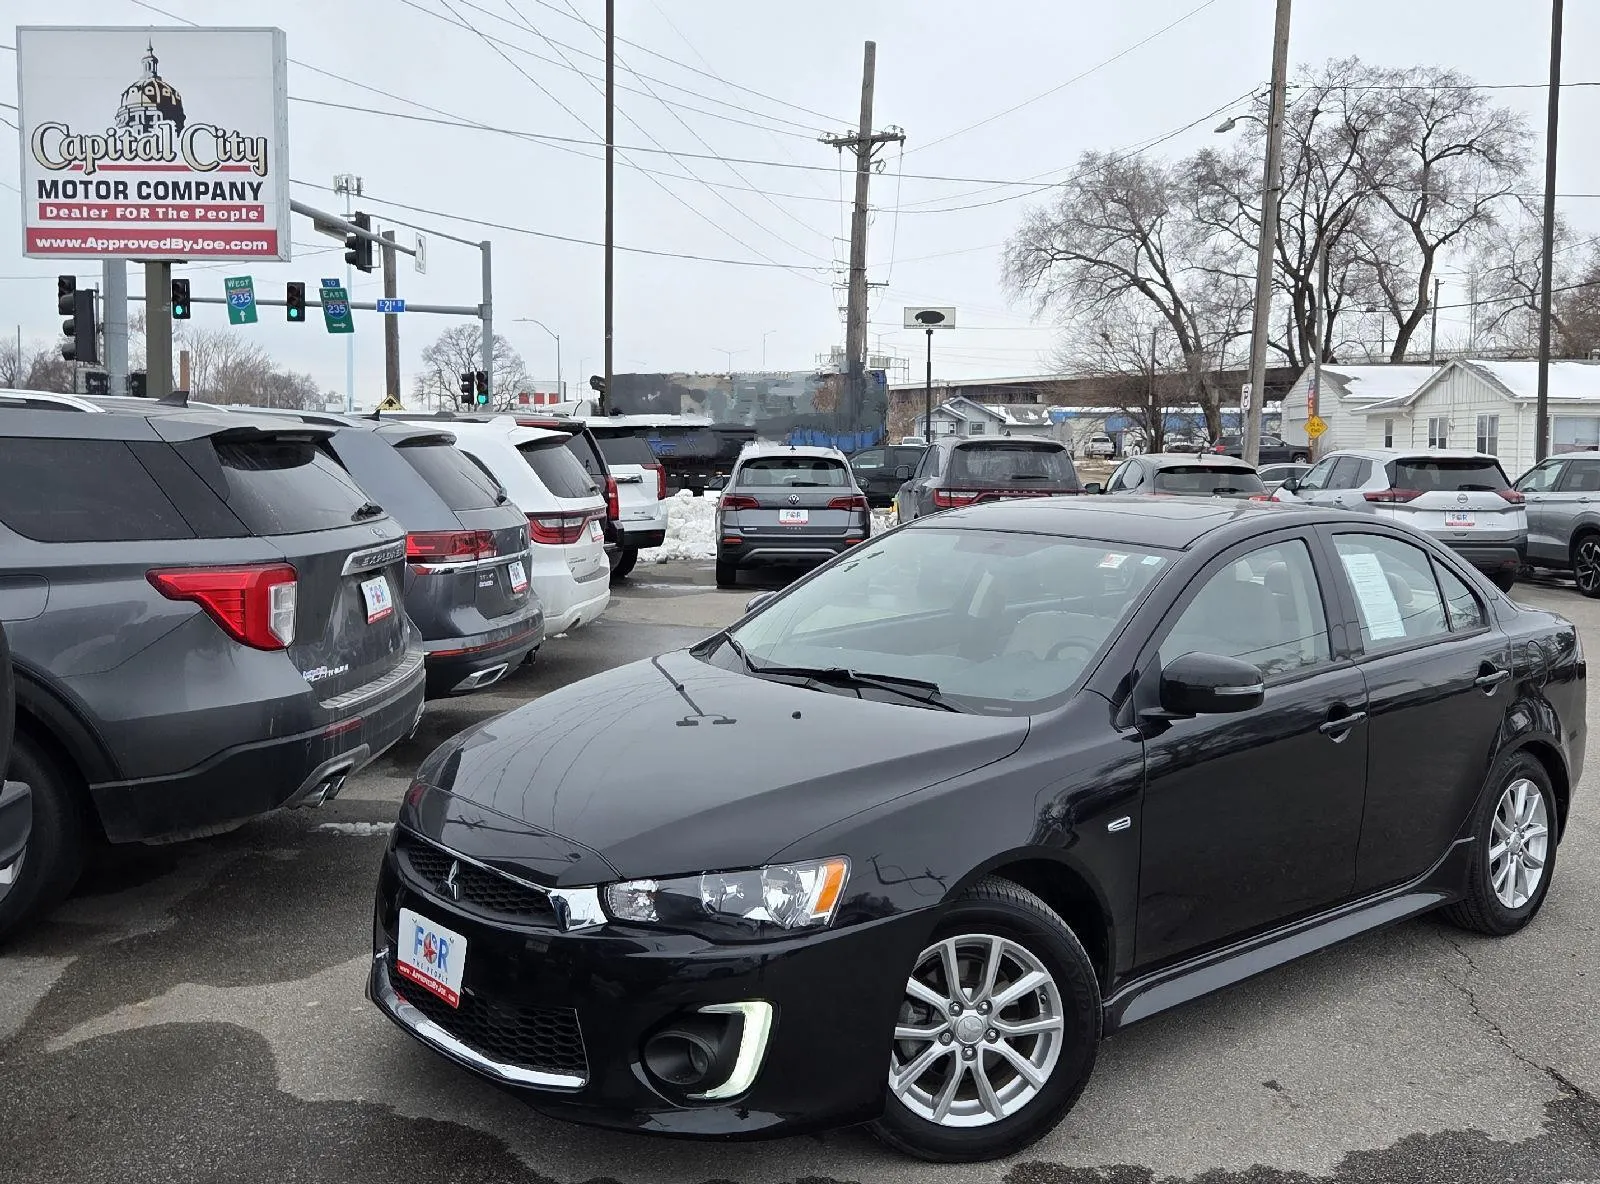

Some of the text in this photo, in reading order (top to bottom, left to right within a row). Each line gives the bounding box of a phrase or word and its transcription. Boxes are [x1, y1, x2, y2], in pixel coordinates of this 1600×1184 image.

[31, 121, 268, 176] Capital City
[38, 179, 263, 201] MOTOR COMPANY
[46, 205, 259, 221] Dealer FOR The People
[36, 236, 267, 251] www.ApprovedByJoe.com
[228, 279, 250, 287] WEST
[231, 293, 251, 304] 235
[323, 290, 345, 298] EAST
[327, 304, 346, 313] 235
[414, 925, 450, 973] FOR
